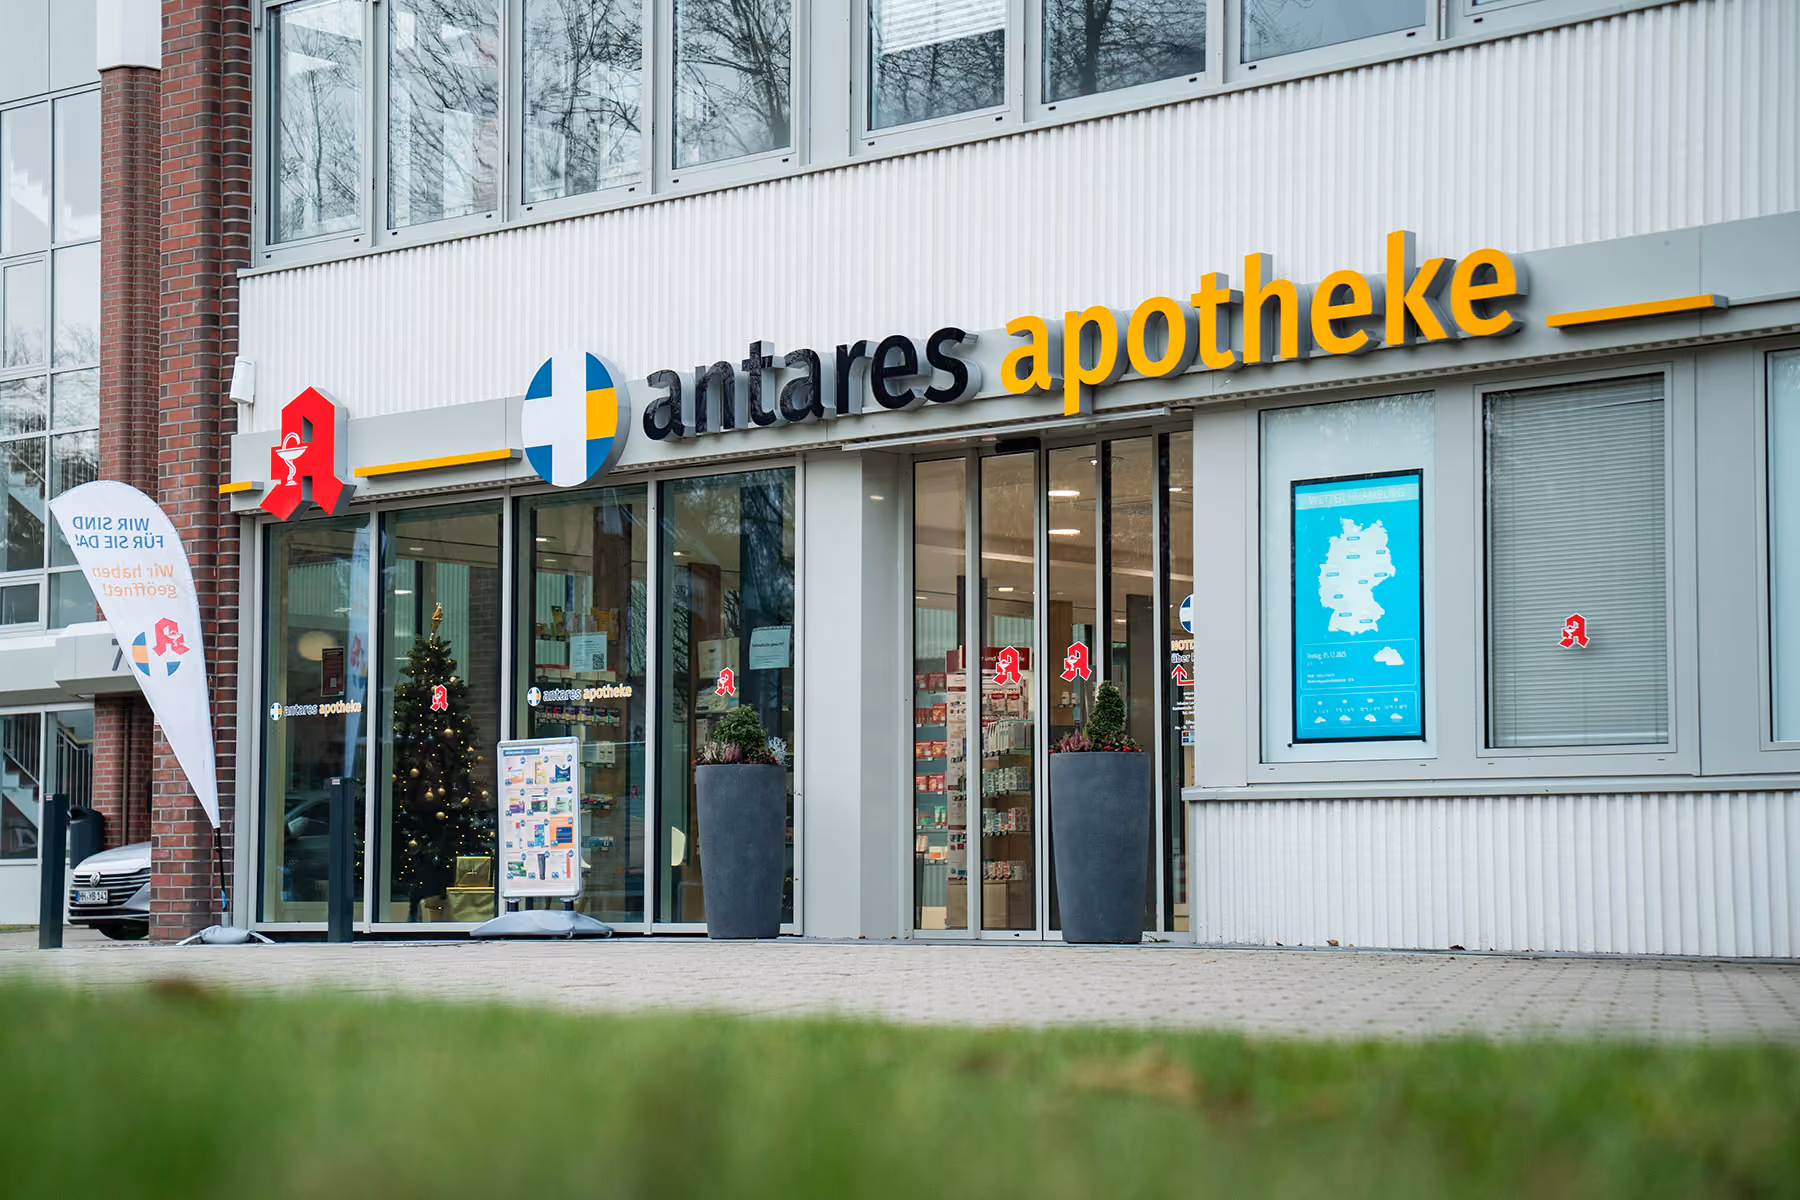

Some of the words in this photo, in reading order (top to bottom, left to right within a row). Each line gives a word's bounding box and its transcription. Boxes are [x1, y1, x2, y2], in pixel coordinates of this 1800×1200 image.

[642, 326, 970, 441] antares
[1000, 229, 1520, 416] apotheke
[543, 688, 582, 701] antares
[583, 683, 632, 702] apotheke
[284, 704, 318, 717] antares
[319, 699, 362, 717] apotheke
